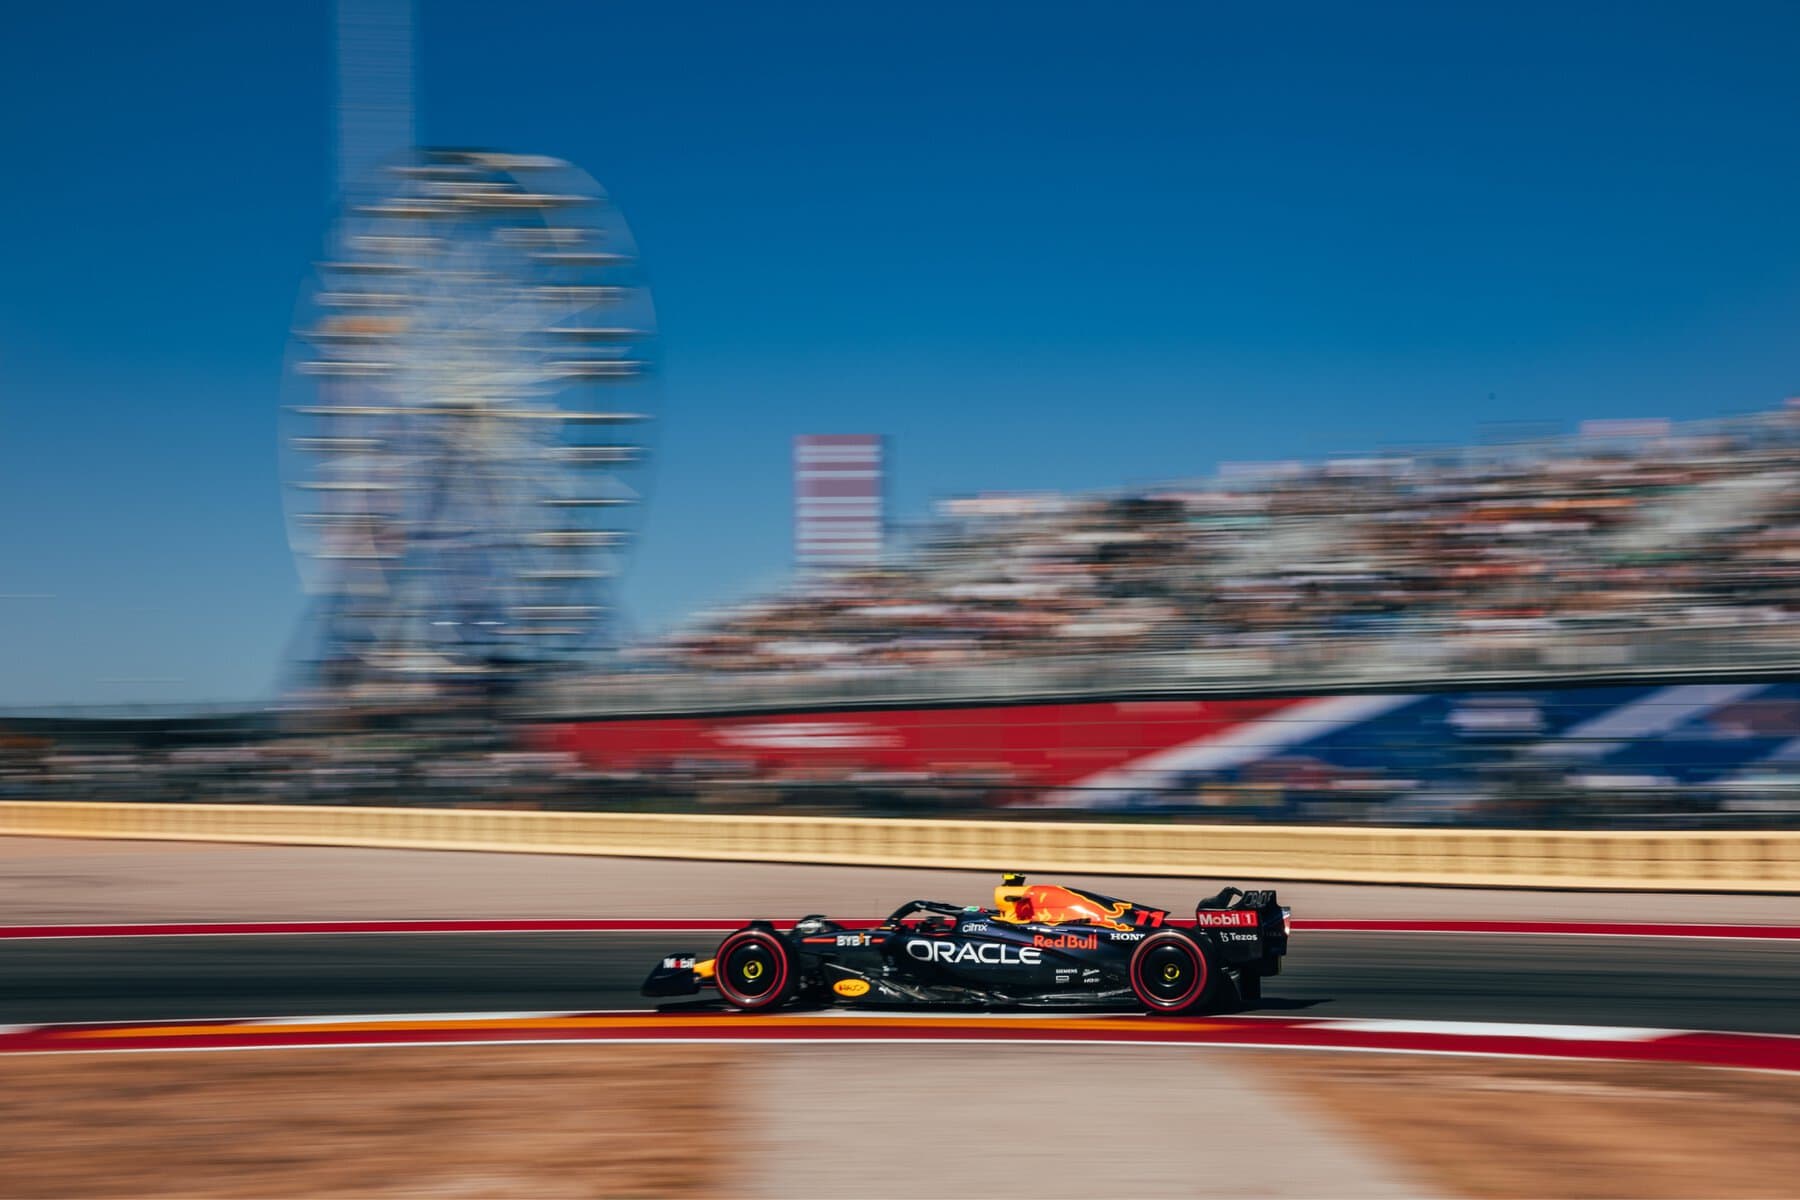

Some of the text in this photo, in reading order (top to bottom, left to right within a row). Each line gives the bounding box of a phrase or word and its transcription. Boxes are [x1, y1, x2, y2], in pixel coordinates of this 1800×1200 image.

[1134, 910, 1166, 928] 11
[1198, 913, 1253, 926] Mobil 1
[1033, 934, 1098, 949] Red Bull
[1110, 933, 1146, 941] HON
[1229, 932, 1258, 941] Tezos
[906, 940, 1043, 964] ORACLE
